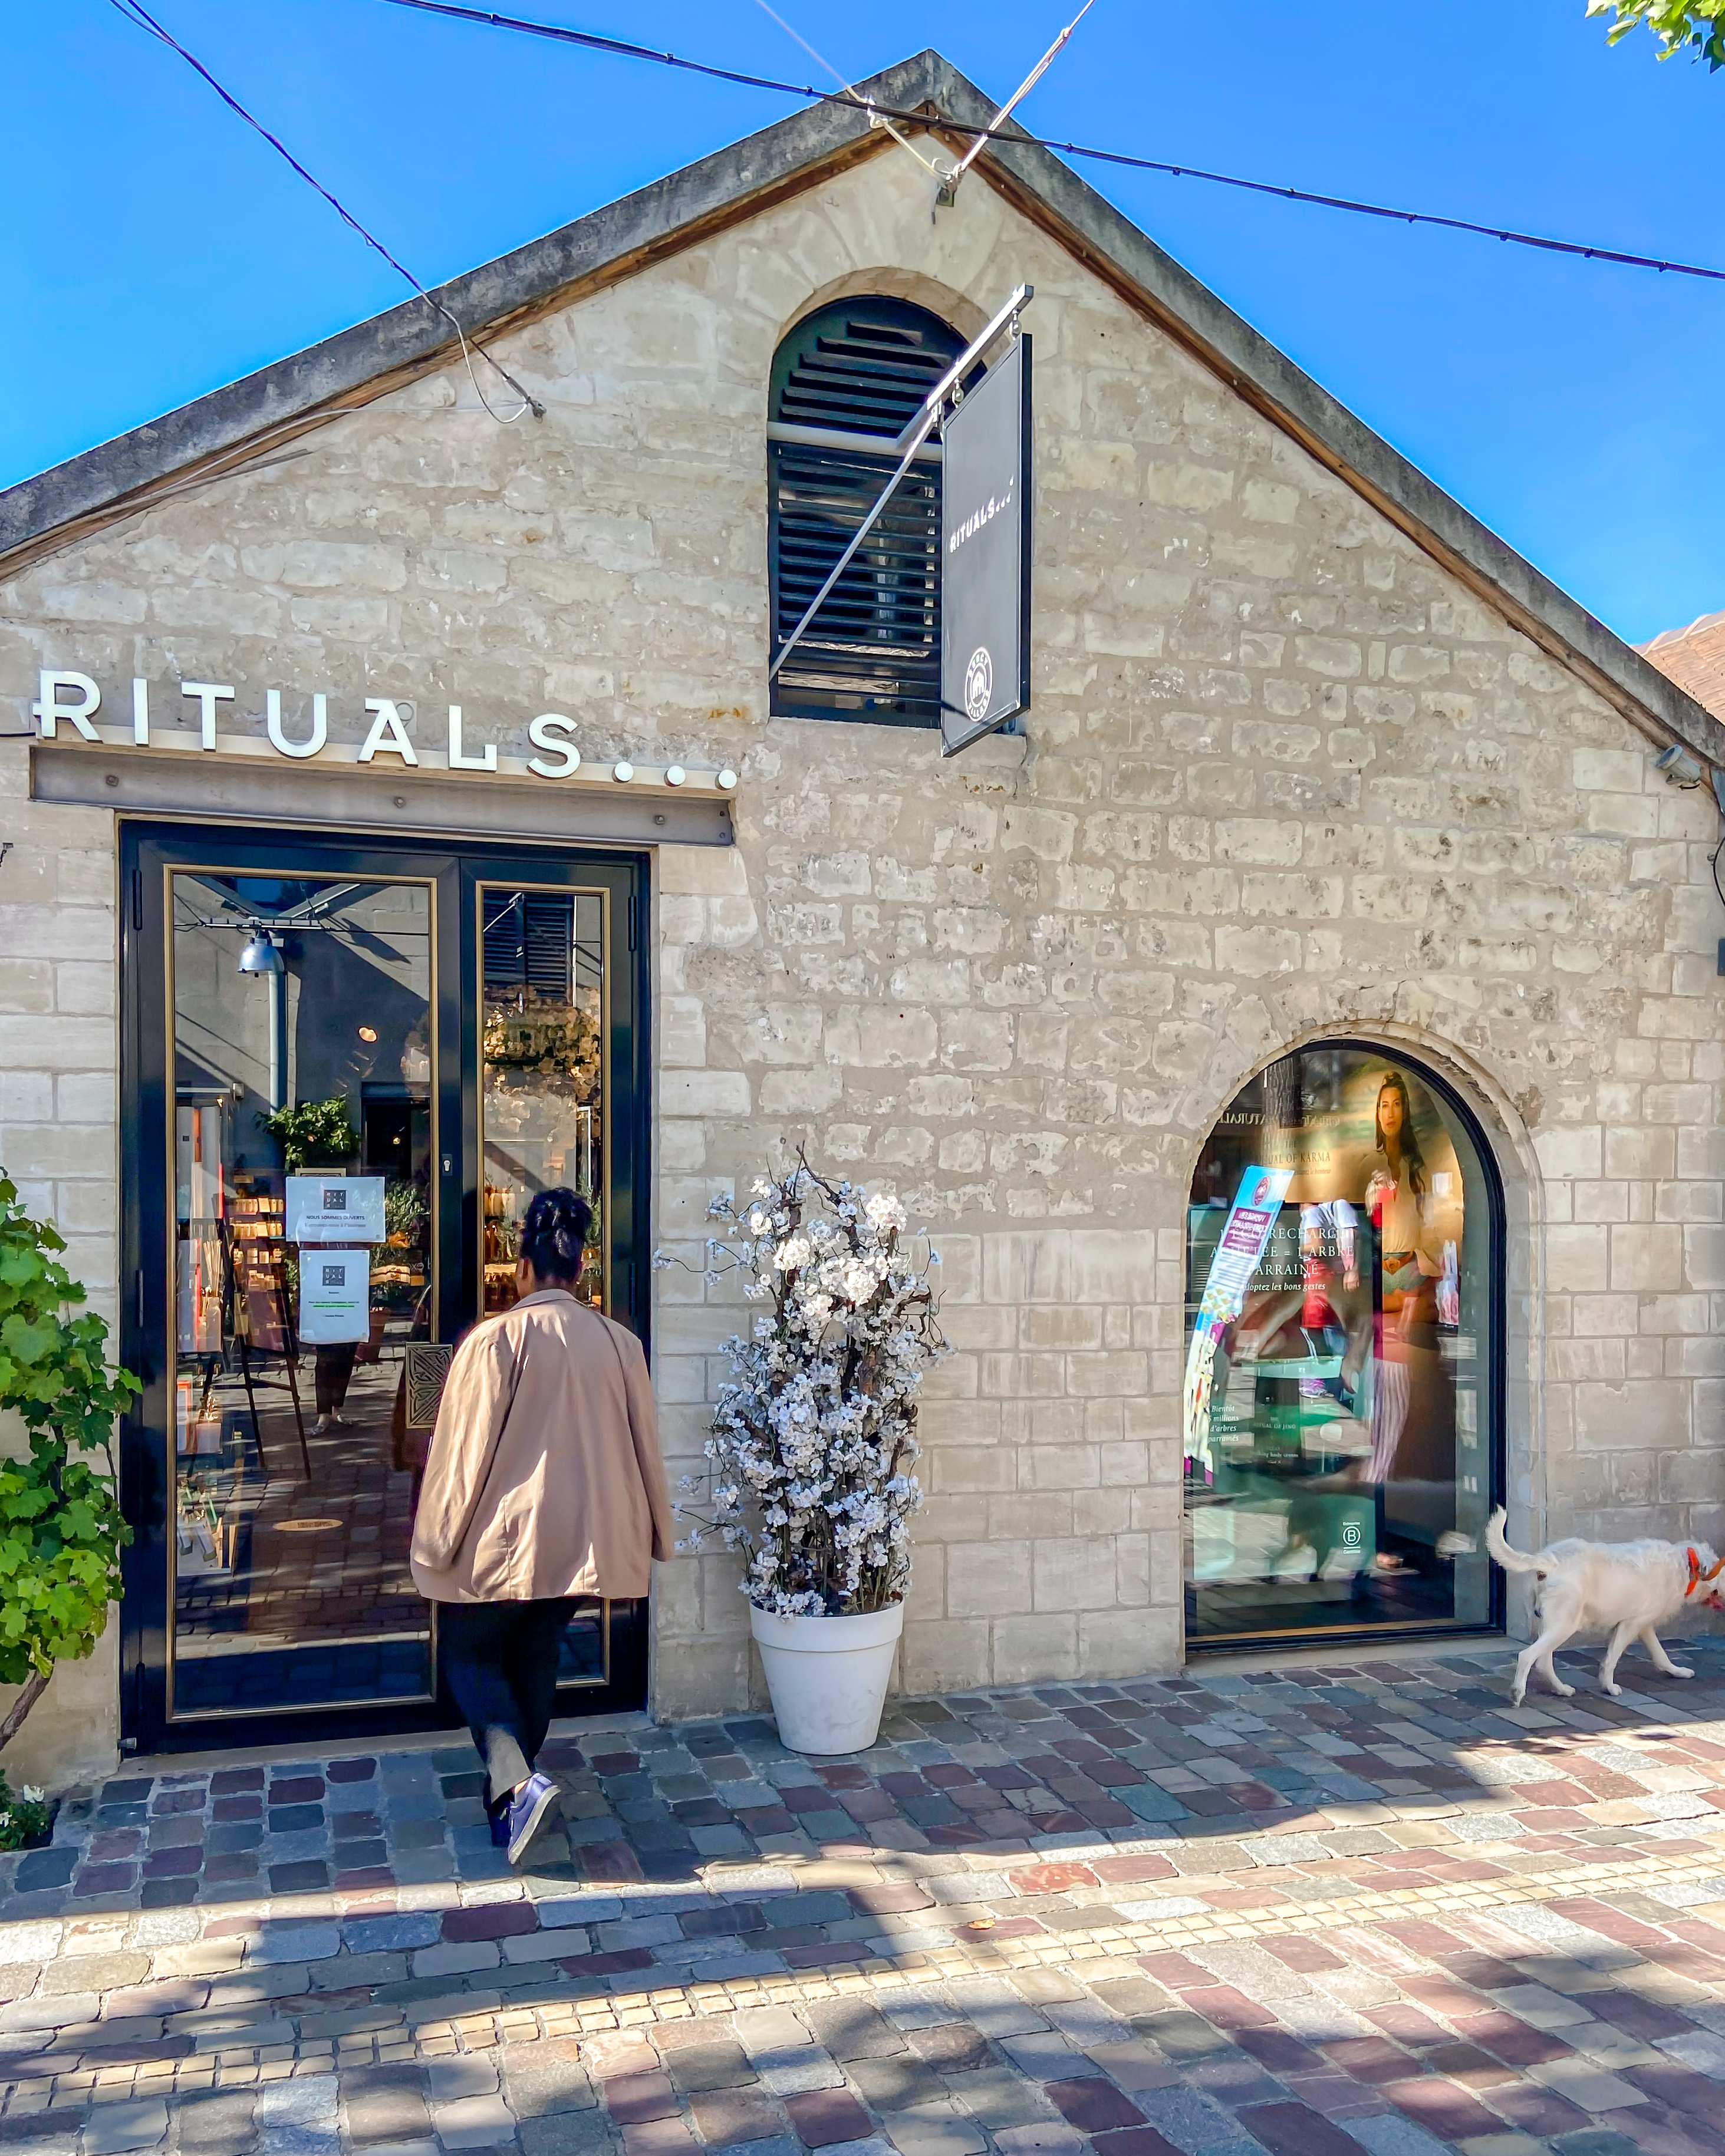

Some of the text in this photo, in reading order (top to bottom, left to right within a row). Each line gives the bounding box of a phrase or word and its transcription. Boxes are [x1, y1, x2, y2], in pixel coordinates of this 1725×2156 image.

[950, 493, 1011, 553] RITUALS...
[32, 670, 738, 789] RITUALS...
[1286, 1153, 1297, 1163] OF
[1301, 1150, 1331, 1163] KARMA
[1309, 1246, 1354, 1257] ARBRE
[1242, 1282, 1326, 1292] doptez les bons gestes
[1212, 1405, 1235, 1413] Bientôt
[1208, 1434, 1239, 1444] parrainés
